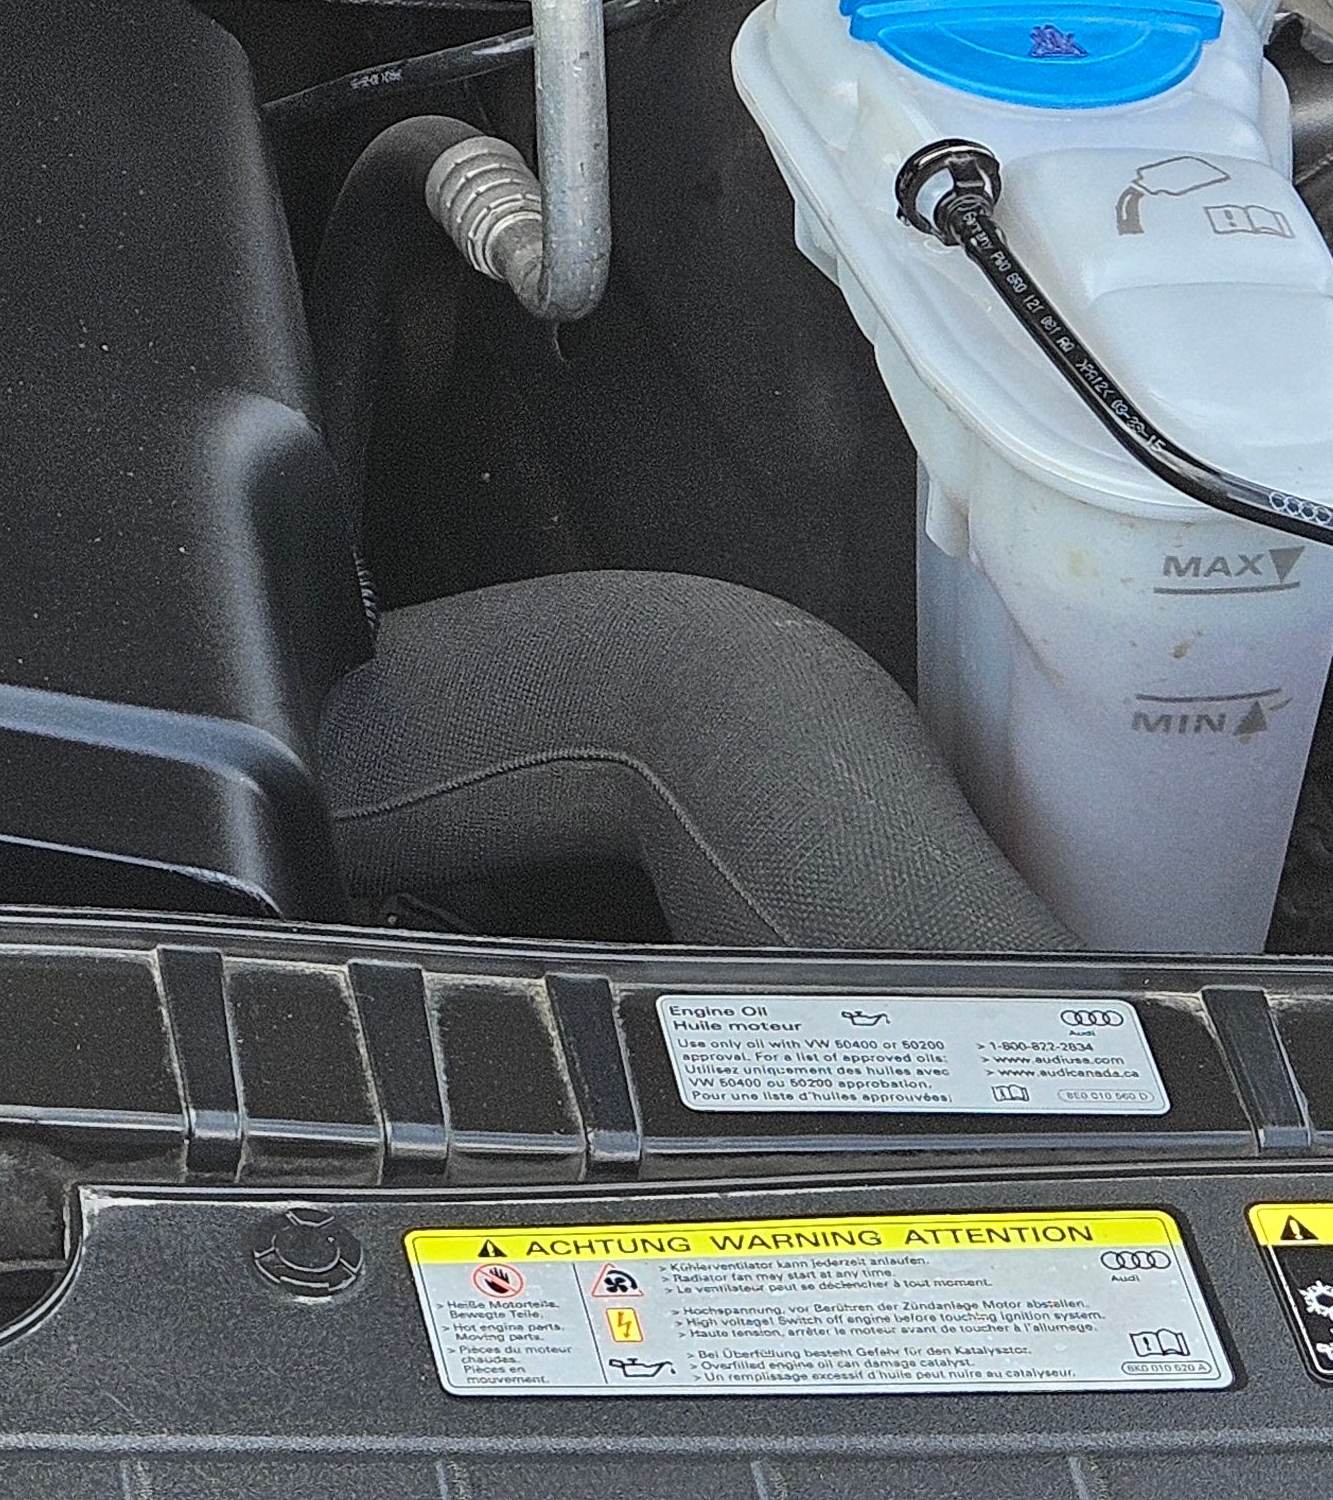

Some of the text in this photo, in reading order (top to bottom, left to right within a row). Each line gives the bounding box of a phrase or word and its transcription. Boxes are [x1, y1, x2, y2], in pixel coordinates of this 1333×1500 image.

[1023, 295, 1044, 313] 121
[1162, 554, 1265, 577] MAX
[1131, 713, 1227, 734] MIN
[669, 1005, 769, 1019] Engine Oil
[673, 1020, 803, 1032] Huile moteur
[1068, 1029, 1096, 1037] Audi
[677, 1038, 945, 1050] Use only oil with VW 50400 or 50200
[682, 1051, 948, 1064] approval. For a list of approved oils:
[993, 1056, 1125, 1065] www.audiusa.com
[684, 1065, 950, 1077] Utilisez uniquement des huiles avec
[998, 1068, 1140, 1078] www.audicanada.ca
[689, 1078, 714, 1088] VW
[719, 1078, 762, 1088] 50400
[767, 1080, 785, 1088] ou
[790, 1079, 833, 1089] 50200
[692, 1090, 726, 1101] Pour
[731, 1093, 759, 1101] une
[763, 1091, 794, 1101] liste
[526, 1225, 1094, 1257] ACHTUNG WARNING ATTENTION
[674, 1269, 896, 1282] Radiator fan may start at any time.
[1111, 1274, 1141, 1282] Audi
[678, 1285, 691, 1293] Le
[696, 1284, 764, 1293] ventilateur
[770, 1283, 796, 1292] peut
[894, 1279, 901, 1288] à
[904, 1279, 931, 1288] tout
[933, 1278, 993, 1287] moment.
[788, 1305, 809, 1313] vor
[877, 1302, 899, 1311] der
[903, 1300, 979, 1311] Zündanlage
[983, 1300, 1022, 1309] Motor
[450, 1310, 506, 1319] Bewegte
[687, 1310, 1106, 1328] High voltage! Switch off engine before touching ignition system.
[453, 1323, 565, 1333] Hot engine parts.
[690, 1328, 729, 1337] Haute
[788, 1327, 830, 1336] arrêter
[835, 1326, 846, 1335] le
[850, 1325, 896, 1334] moteur
[901, 1325, 938, 1334] avant
[941, 1324, 957, 1333] de
[960, 1323, 1010, 1333] toucher
[1014, 1323, 1021, 1332] à
[456, 1333, 505, 1342] Moving
[505, 1345, 521, 1354] du
[526, 1346, 573, 1354] moteur
[699, 1350, 719, 1359] Bei
[804, 1348, 853, 1358] besteht
[856, 1347, 900, 1357] Gefahr
[904, 1346, 922, 1356] für
[927, 1347, 952, 1356] den
[702, 1361, 765, 1371] Overfilled
[769, 1361, 813, 1372] engine
[818, 1360, 834, 1369] oil
[864, 1359, 917, 1369] damage
[1151, 1364, 1172, 1372] 010
[1198, 1363, 1207, 1371] A
[705, 1367, 1076, 1383] Un remplissage excessif d'huile peut nuire au catalyseur.
